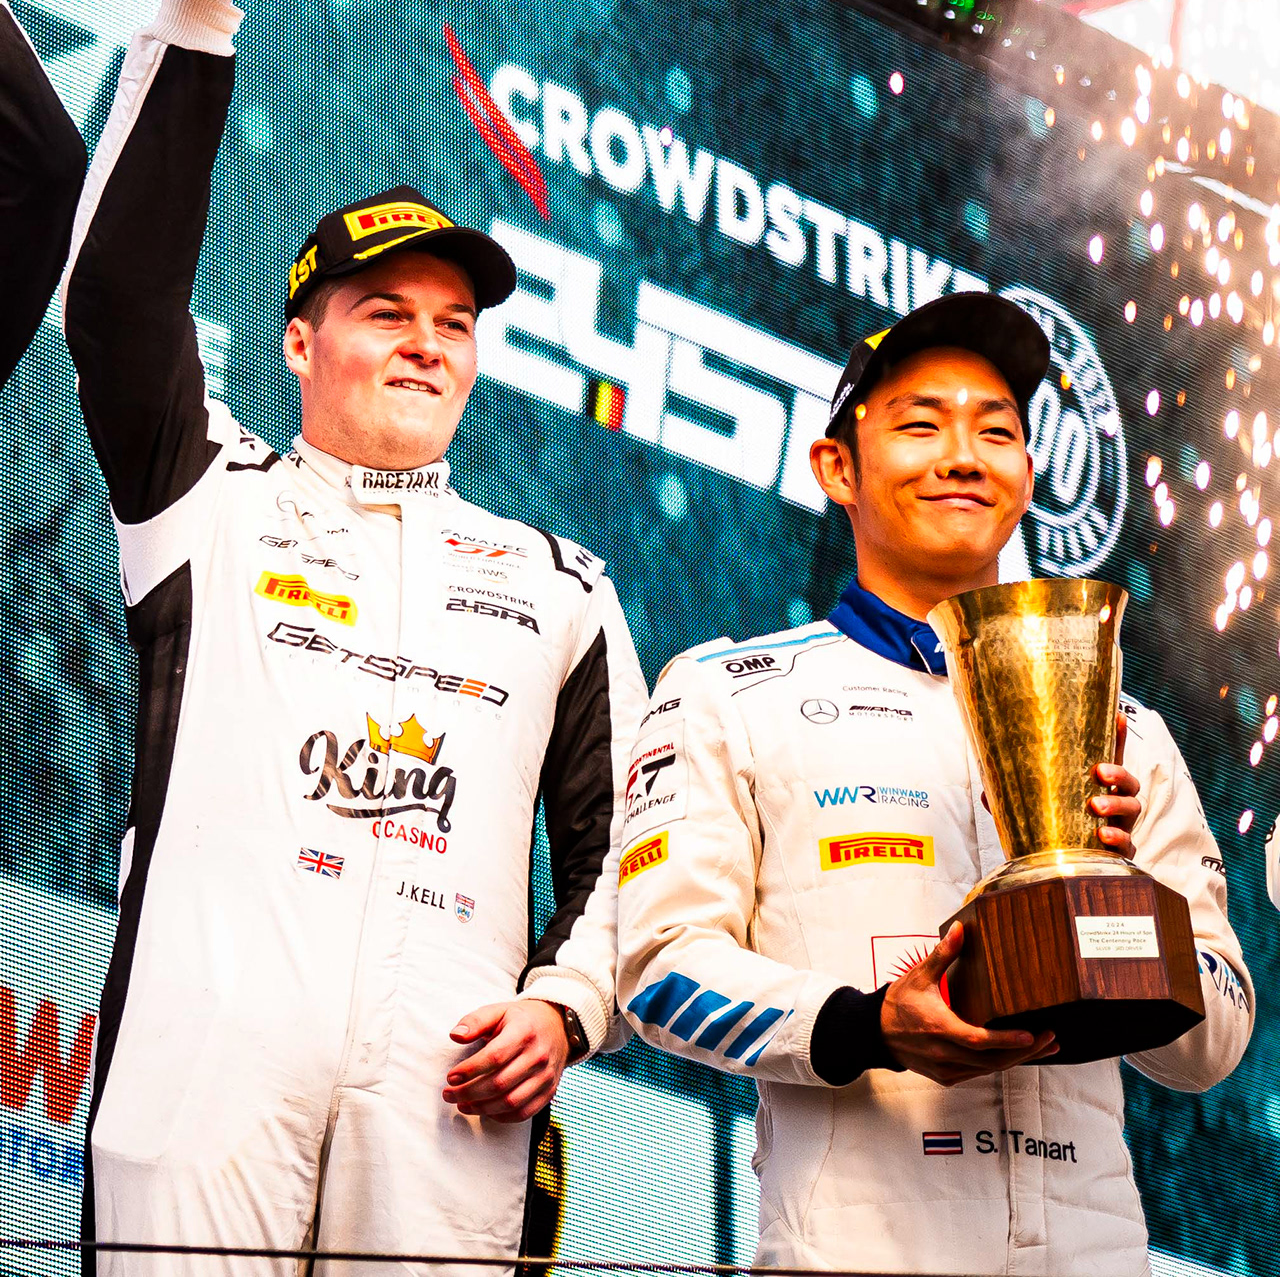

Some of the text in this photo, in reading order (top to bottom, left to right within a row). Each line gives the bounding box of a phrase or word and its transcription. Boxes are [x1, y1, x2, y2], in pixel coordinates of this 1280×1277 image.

[447, 585, 537, 611] CROWDSTRIKE
[266, 622, 510, 708] GETSPEED
[725, 656, 777, 673] OMP
[842, 684, 909, 697] Customer Racing
[848, 711, 914, 722] MOTORSPORT
[298, 730, 457, 833] King
[879, 786, 929, 801] WINWARD
[881, 795, 930, 809] RACING
[828, 836, 925, 864] PIRELLI
[396, 881, 446, 910] J.KELL
